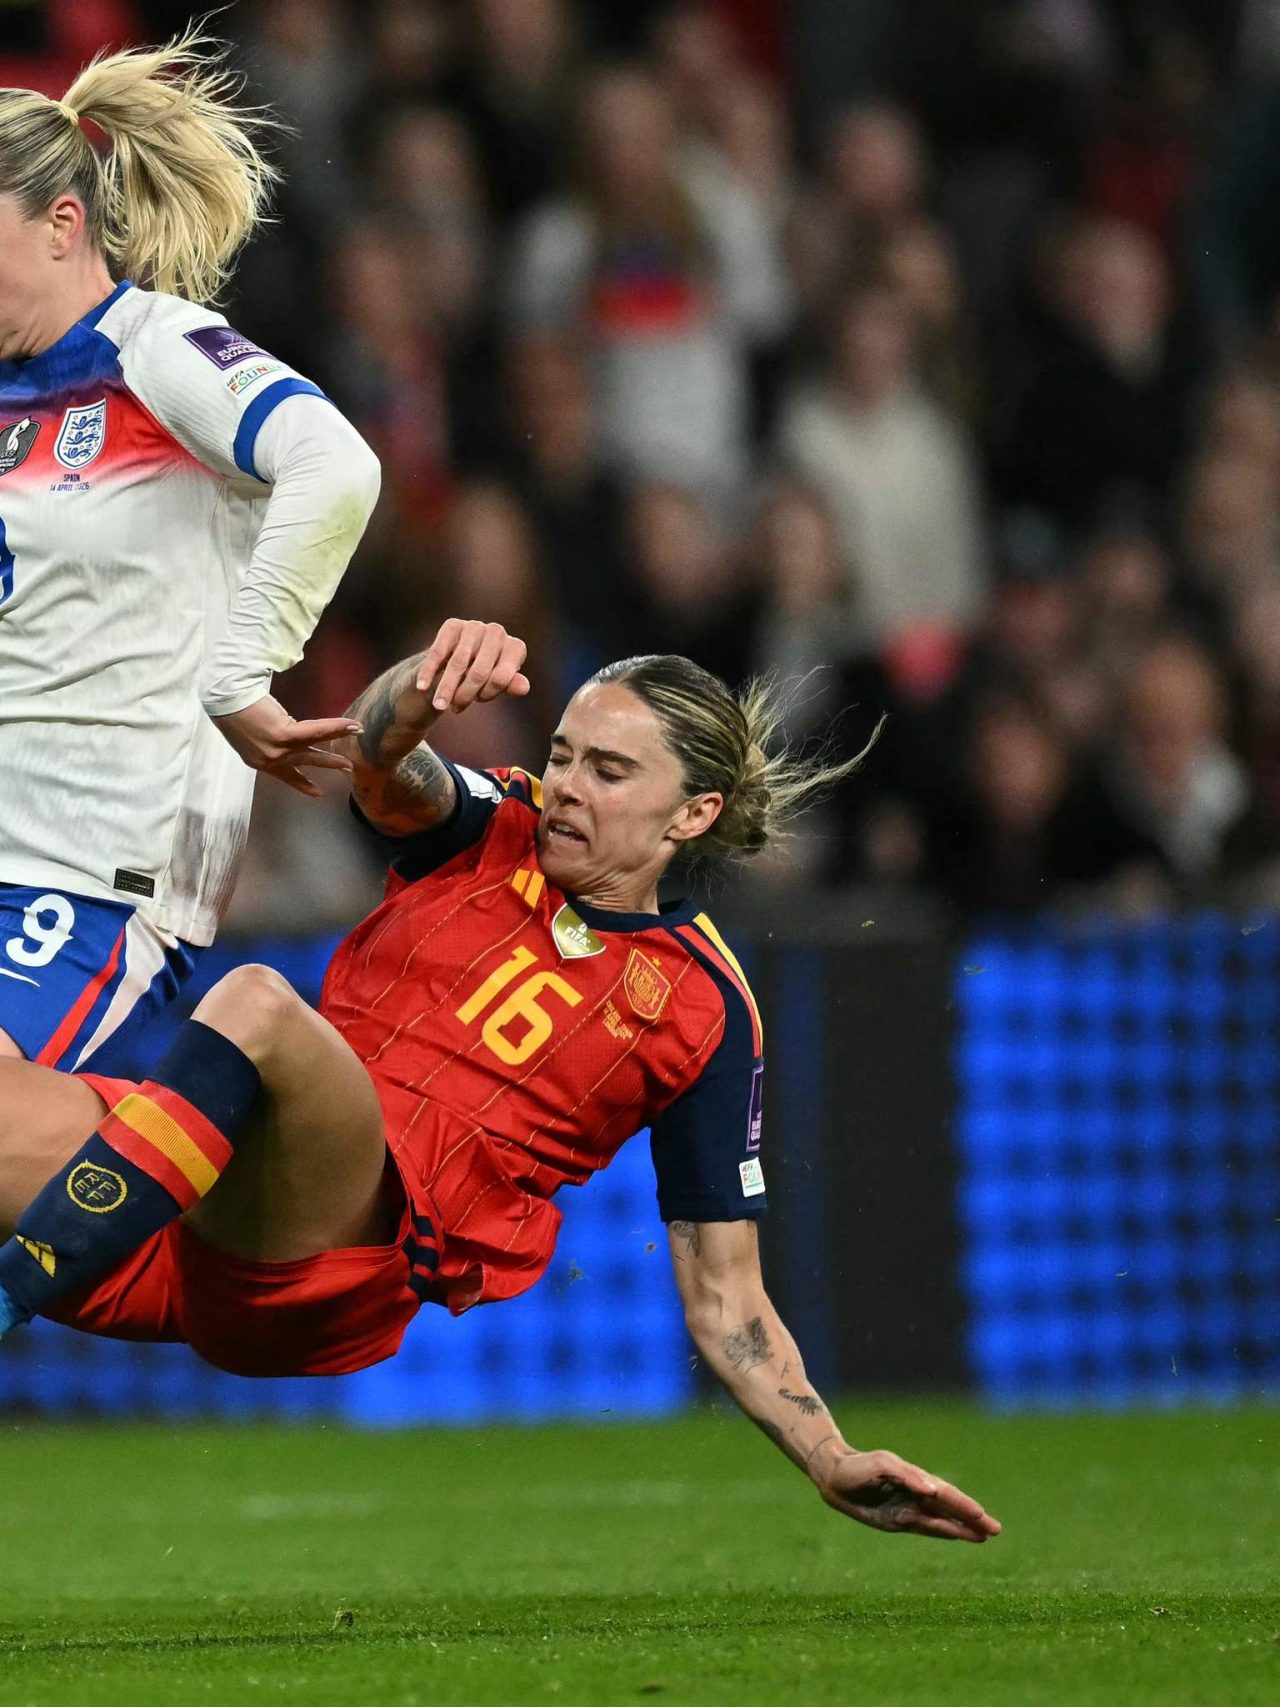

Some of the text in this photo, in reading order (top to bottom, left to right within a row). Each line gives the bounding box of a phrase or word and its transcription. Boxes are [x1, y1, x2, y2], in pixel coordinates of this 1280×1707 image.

[227, 370, 245, 386] UEFA
[64, 474, 80, 482] SPAIN
[6, 893, 75, 967] 9
[565, 926, 588, 946] FIFA
[455, 945, 584, 1065] 16
